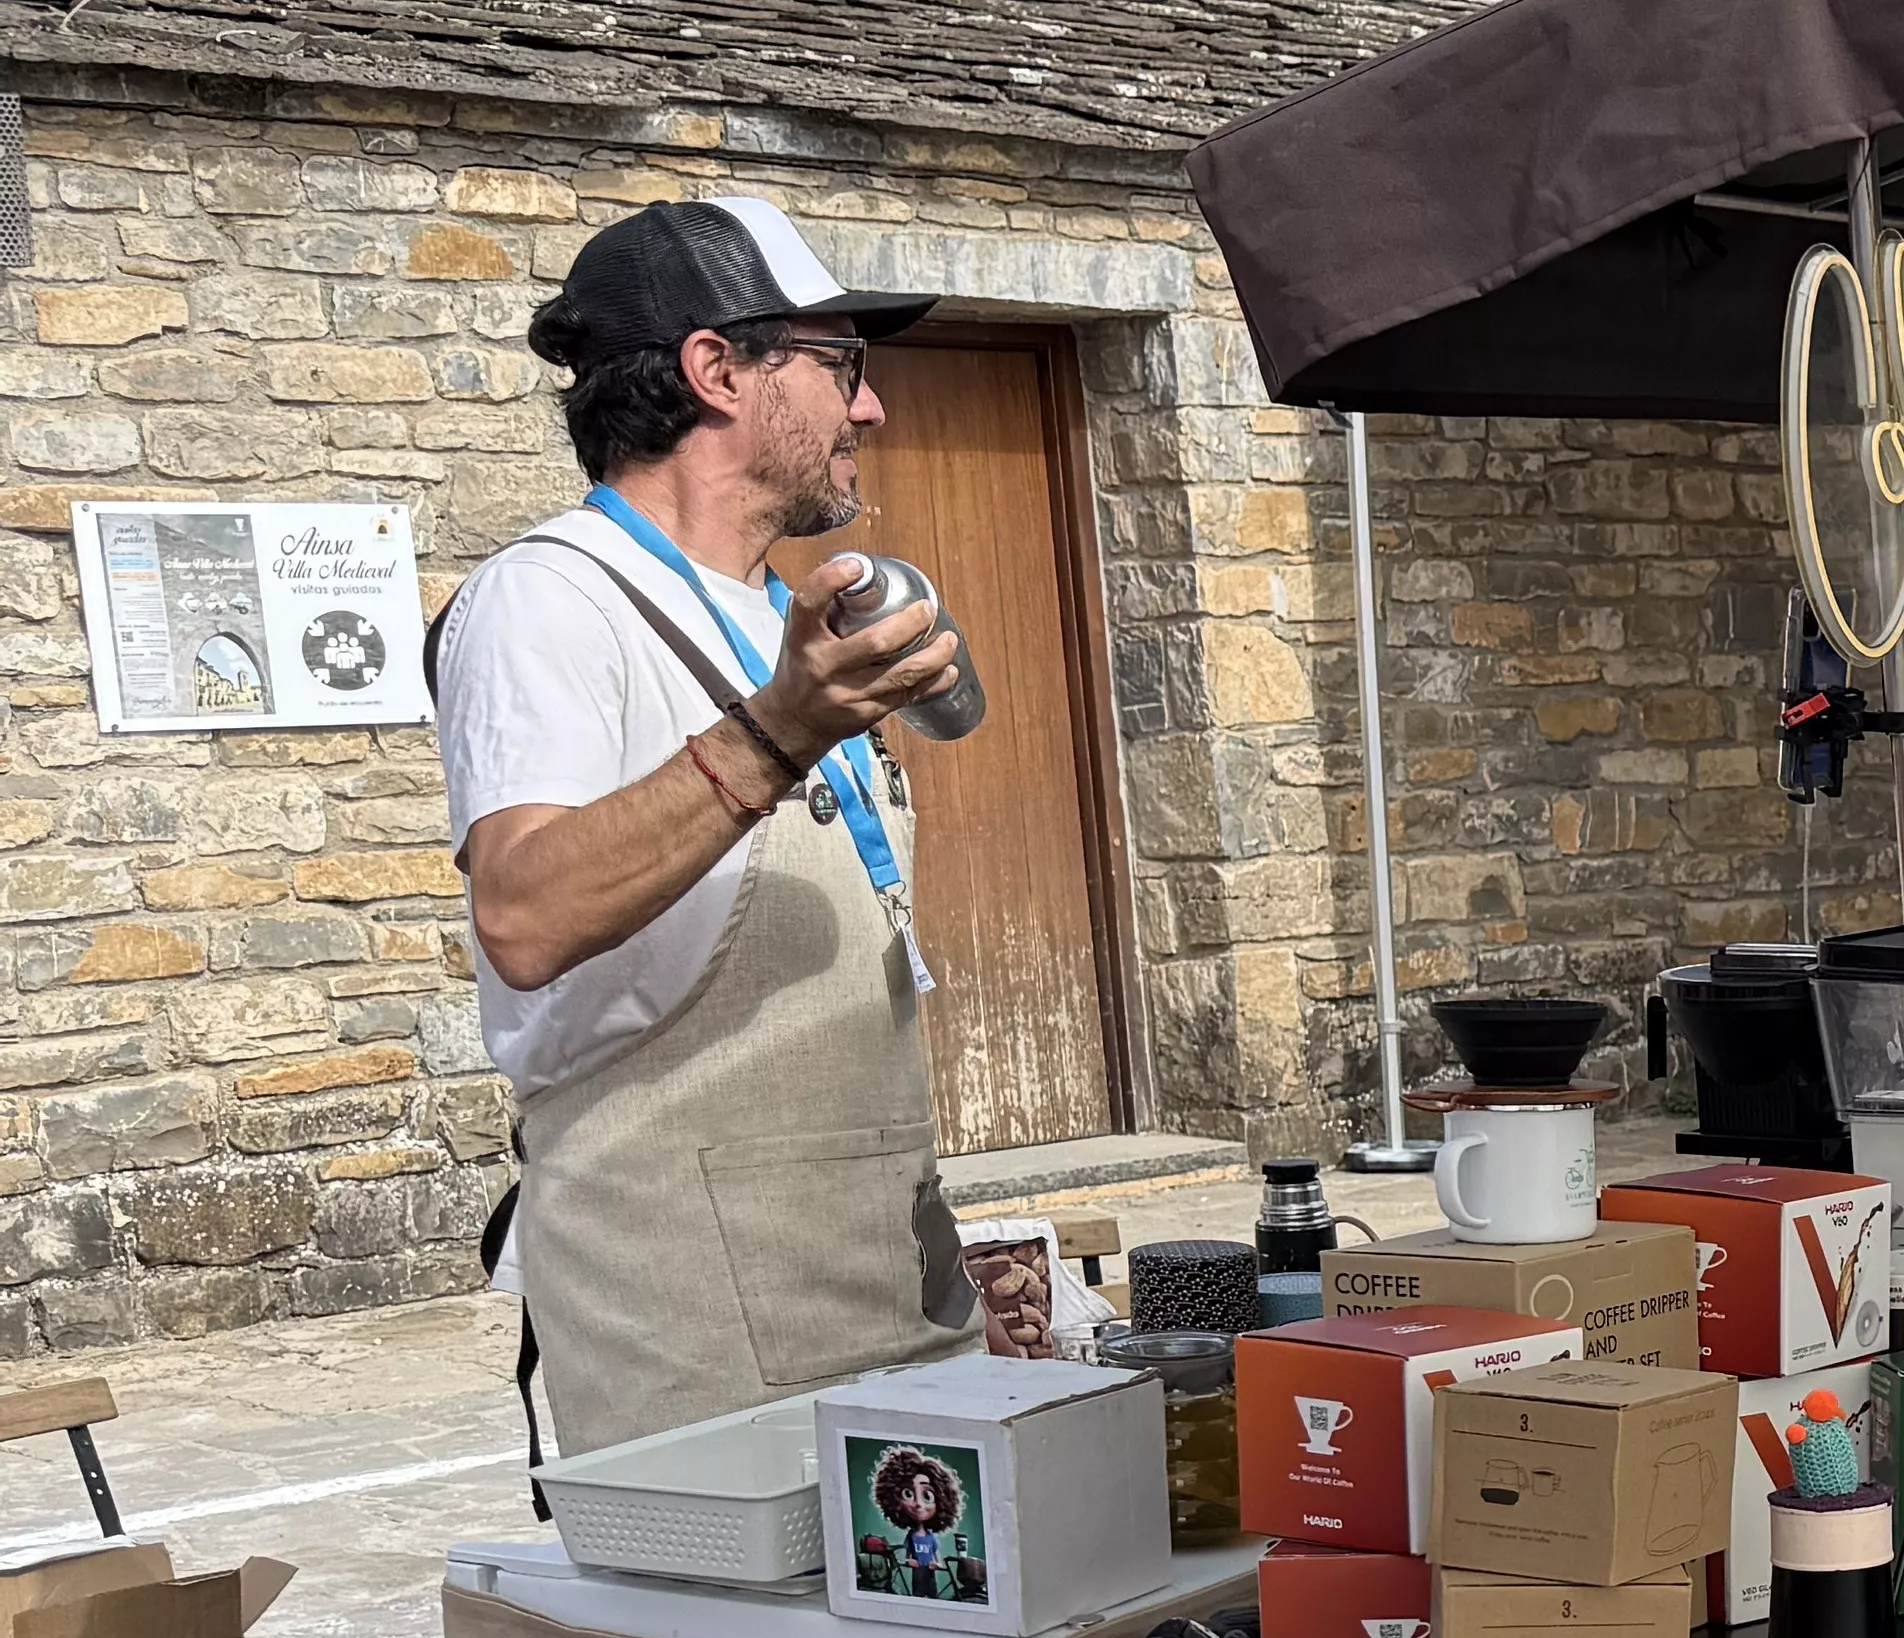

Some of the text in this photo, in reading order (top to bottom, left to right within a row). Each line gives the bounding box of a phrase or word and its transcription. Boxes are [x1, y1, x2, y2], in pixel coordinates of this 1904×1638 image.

[272, 558, 397, 580] Villa Medieval
[1825, 1200, 1854, 1216] HARIO
[1334, 1272, 1421, 1299] COFFEE
[1584, 1290, 1691, 1332] COFFEE DRIPPER
[1587, 1334, 1618, 1360] AND
[1475, 1350, 1521, 1369] HARIO
[1519, 1413, 1534, 1436] 3.
[1303, 1514, 1344, 1530] HARIO
[1561, 1599, 1578, 1620] 3.
